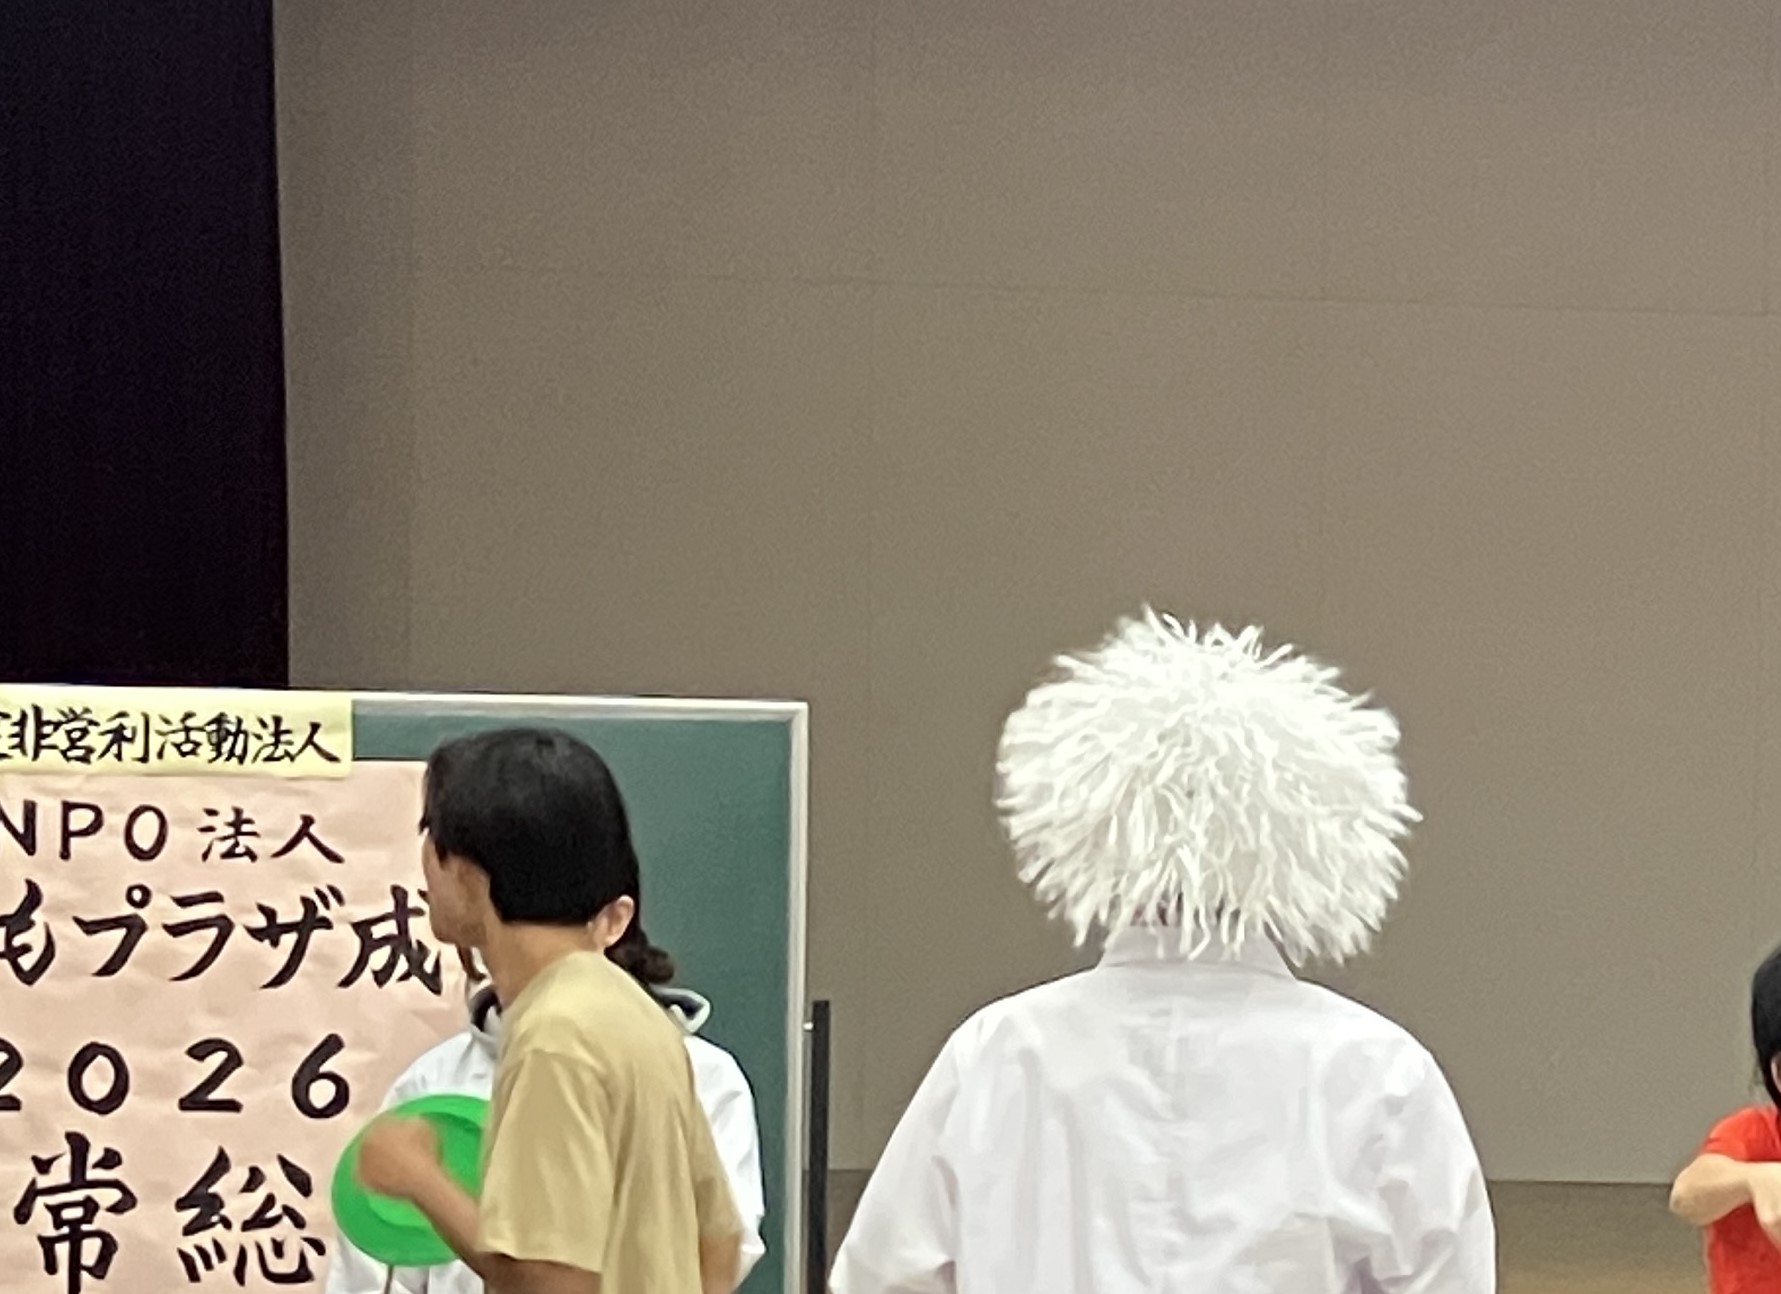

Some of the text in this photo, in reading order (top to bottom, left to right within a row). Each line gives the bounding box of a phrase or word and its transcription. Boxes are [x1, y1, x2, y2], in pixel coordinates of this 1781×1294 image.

[0, 703, 342, 766] 非営利活動法人
